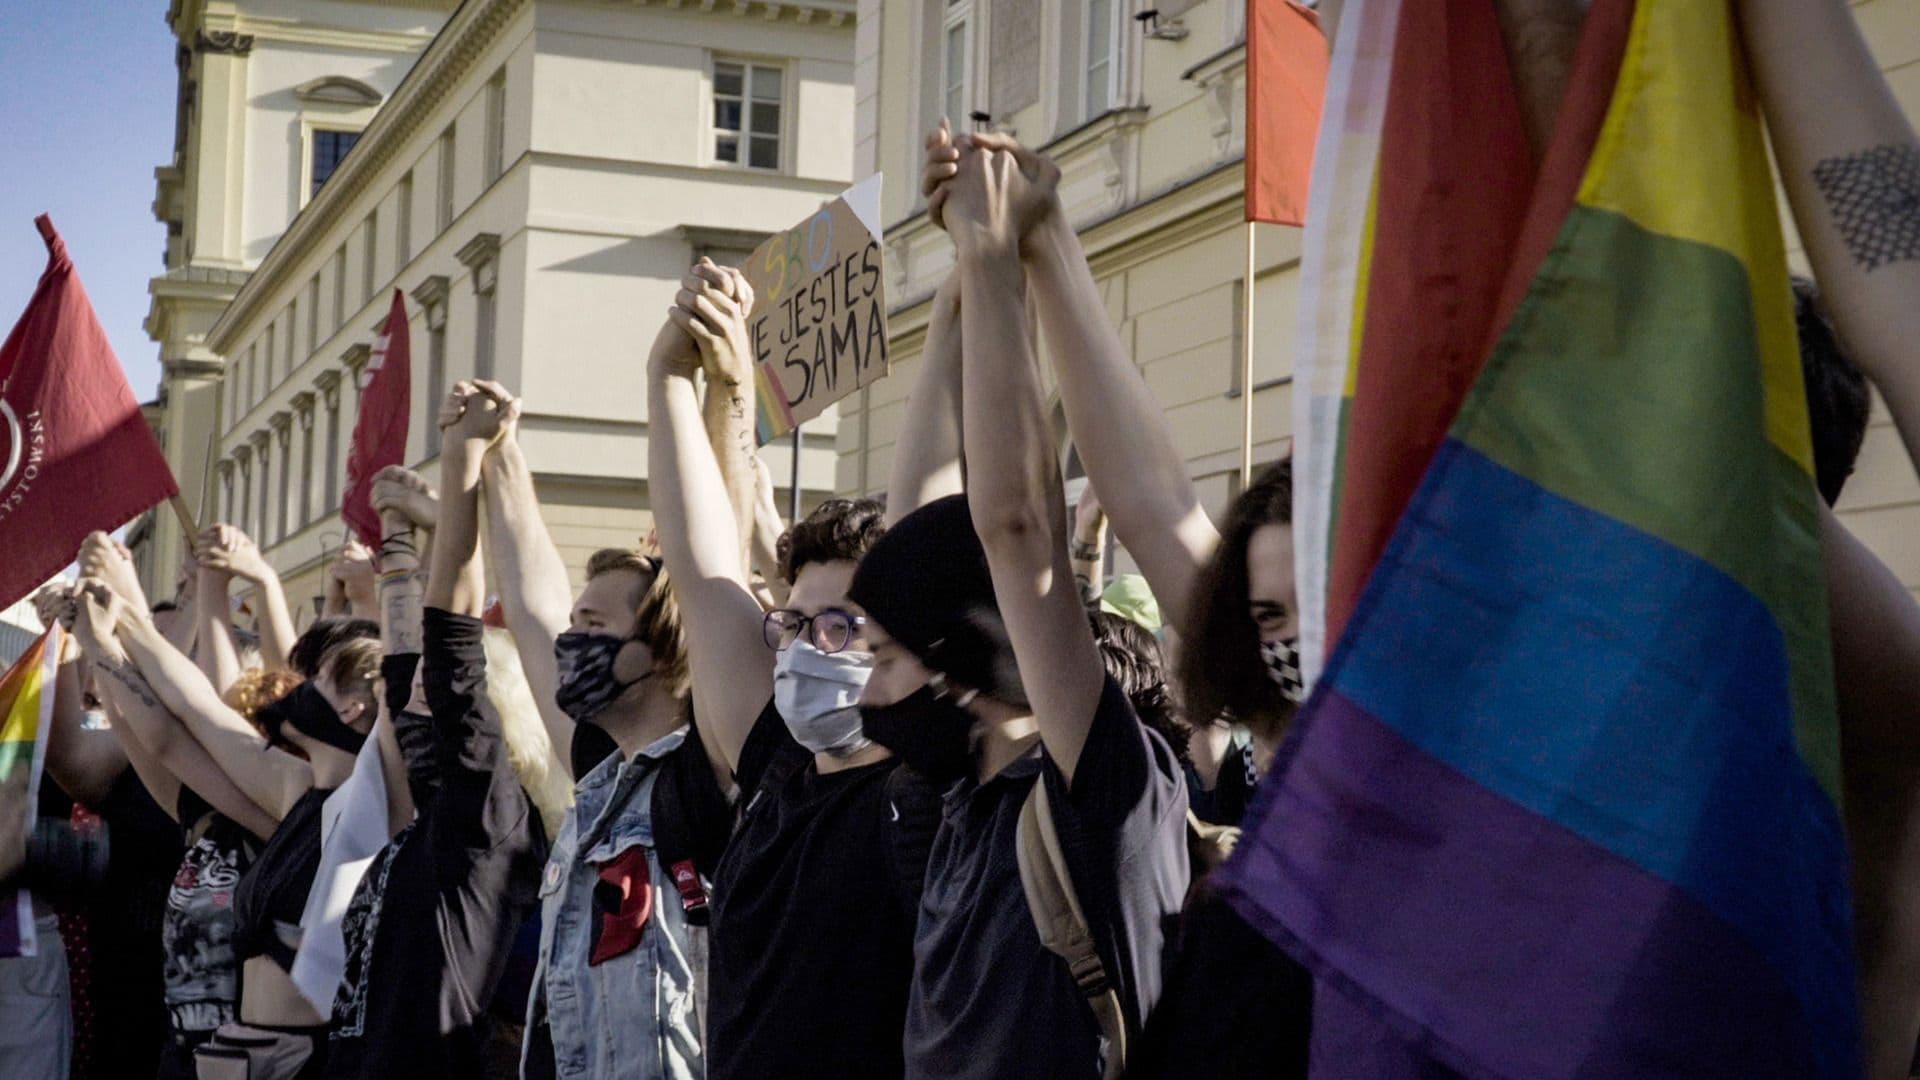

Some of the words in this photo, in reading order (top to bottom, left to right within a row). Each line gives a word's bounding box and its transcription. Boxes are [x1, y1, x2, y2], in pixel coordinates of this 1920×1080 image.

[751, 315, 772, 362] IE
[784, 297, 886, 408] SAMA
[0, 410, 44, 520] YSTOWSKI
